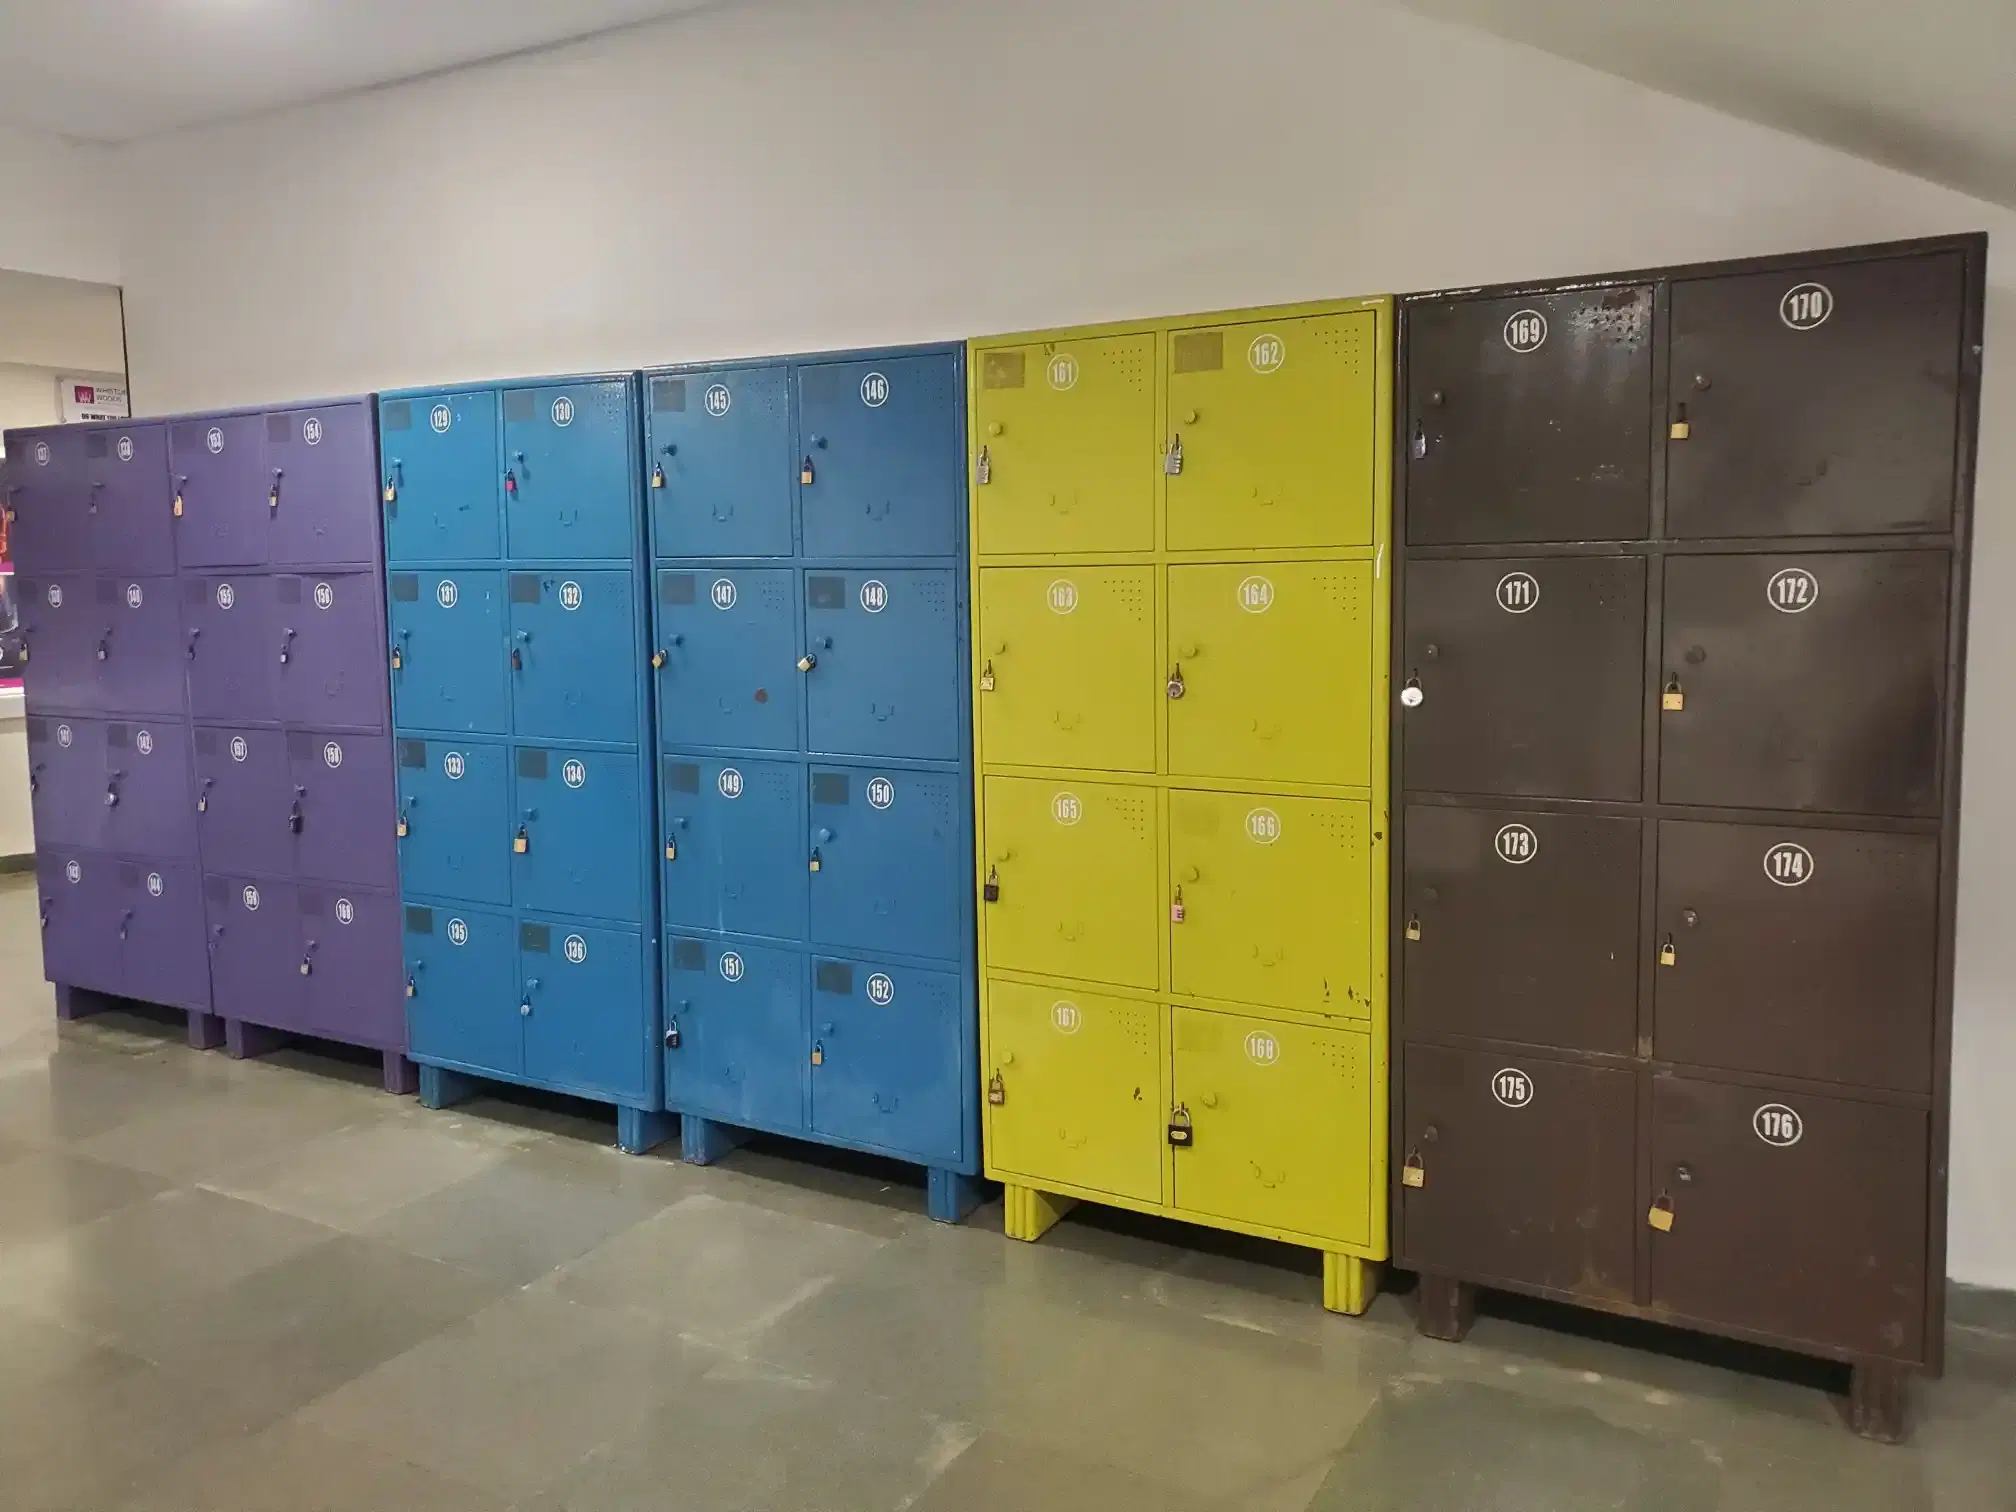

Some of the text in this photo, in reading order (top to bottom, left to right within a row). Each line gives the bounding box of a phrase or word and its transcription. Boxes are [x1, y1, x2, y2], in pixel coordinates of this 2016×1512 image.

[1789, 291, 1822, 321] 170
[1510, 318, 1540, 345] 169
[1254, 342, 1278, 365] 162
[1053, 362, 1072, 383] 161
[865, 379, 884, 400] 146
[709, 390, 726, 410] 145
[434, 410, 448, 427] 129
[555, 402, 570, 421] 130
[307, 423, 319, 439] 154
[441, 585, 453, 603] 131
[563, 587, 578, 605] 132
[716, 585, 731, 604] 147
[865, 587, 883, 607] 148
[1052, 587, 1072, 606] 163
[1244, 584, 1267, 605] 164
[1505, 581, 1529, 605] 171
[1777, 578, 1808, 604] 172
[447, 757, 461, 774] 133
[566, 765, 582, 783] 134
[722, 774, 739, 793] 149
[871, 784, 889, 803] 150
[1056, 799, 1077, 819] 165
[1251, 815, 1274, 836] 166
[1503, 832, 1528, 856] 173
[1773, 852, 1803, 877] 174
[451, 923, 464, 940] 135
[568, 941, 582, 959] 136
[724, 958, 739, 976] 151
[871, 980, 888, 999] 152
[1057, 1007, 1075, 1026] 167
[1251, 1038, 1273, 1059] 168
[1500, 1076, 1525, 1100] 175
[1762, 1112, 1792, 1138] 176
